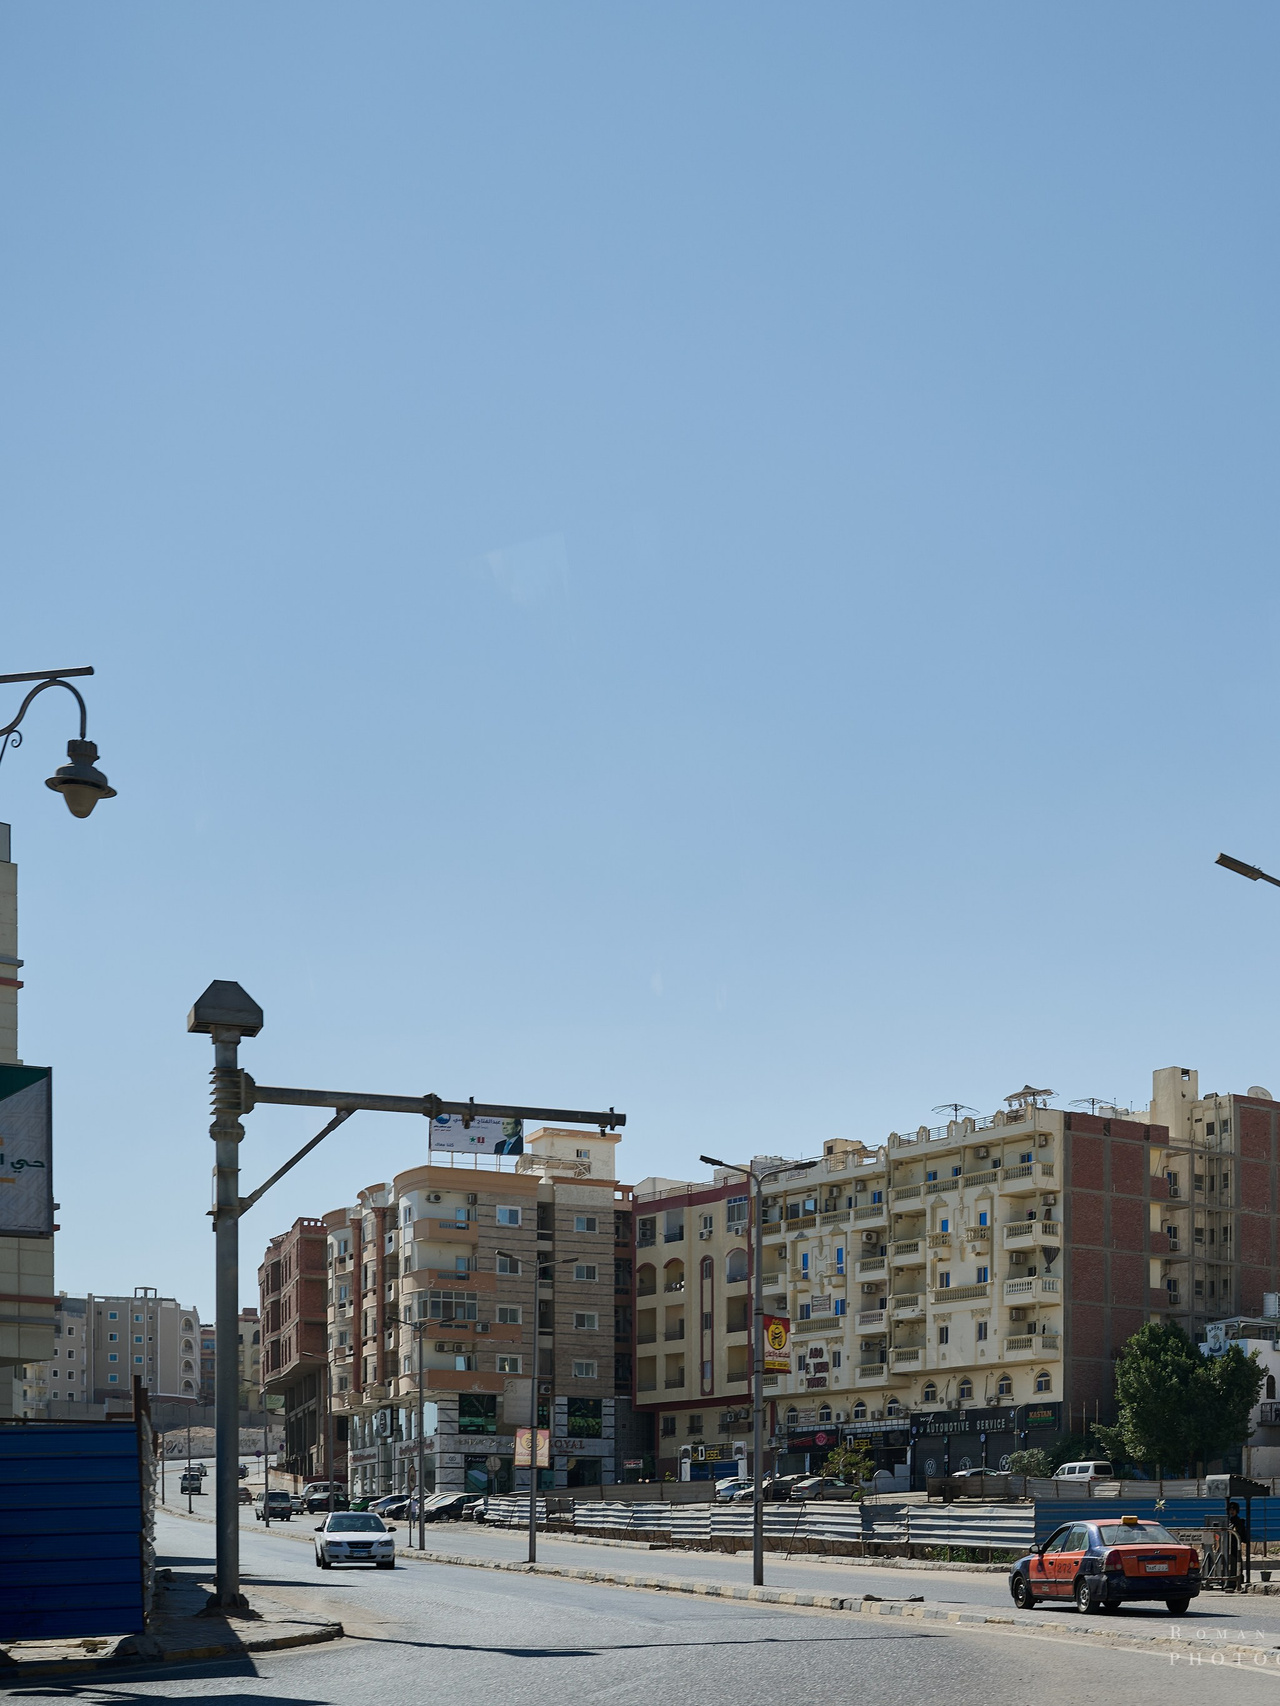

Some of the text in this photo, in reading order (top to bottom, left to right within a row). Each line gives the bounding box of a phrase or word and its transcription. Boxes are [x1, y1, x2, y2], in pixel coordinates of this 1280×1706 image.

[926, 1418, 1006, 1434] AUTOMOTIVE SERVICE
[1057, 1562, 1072, 1574] 272
